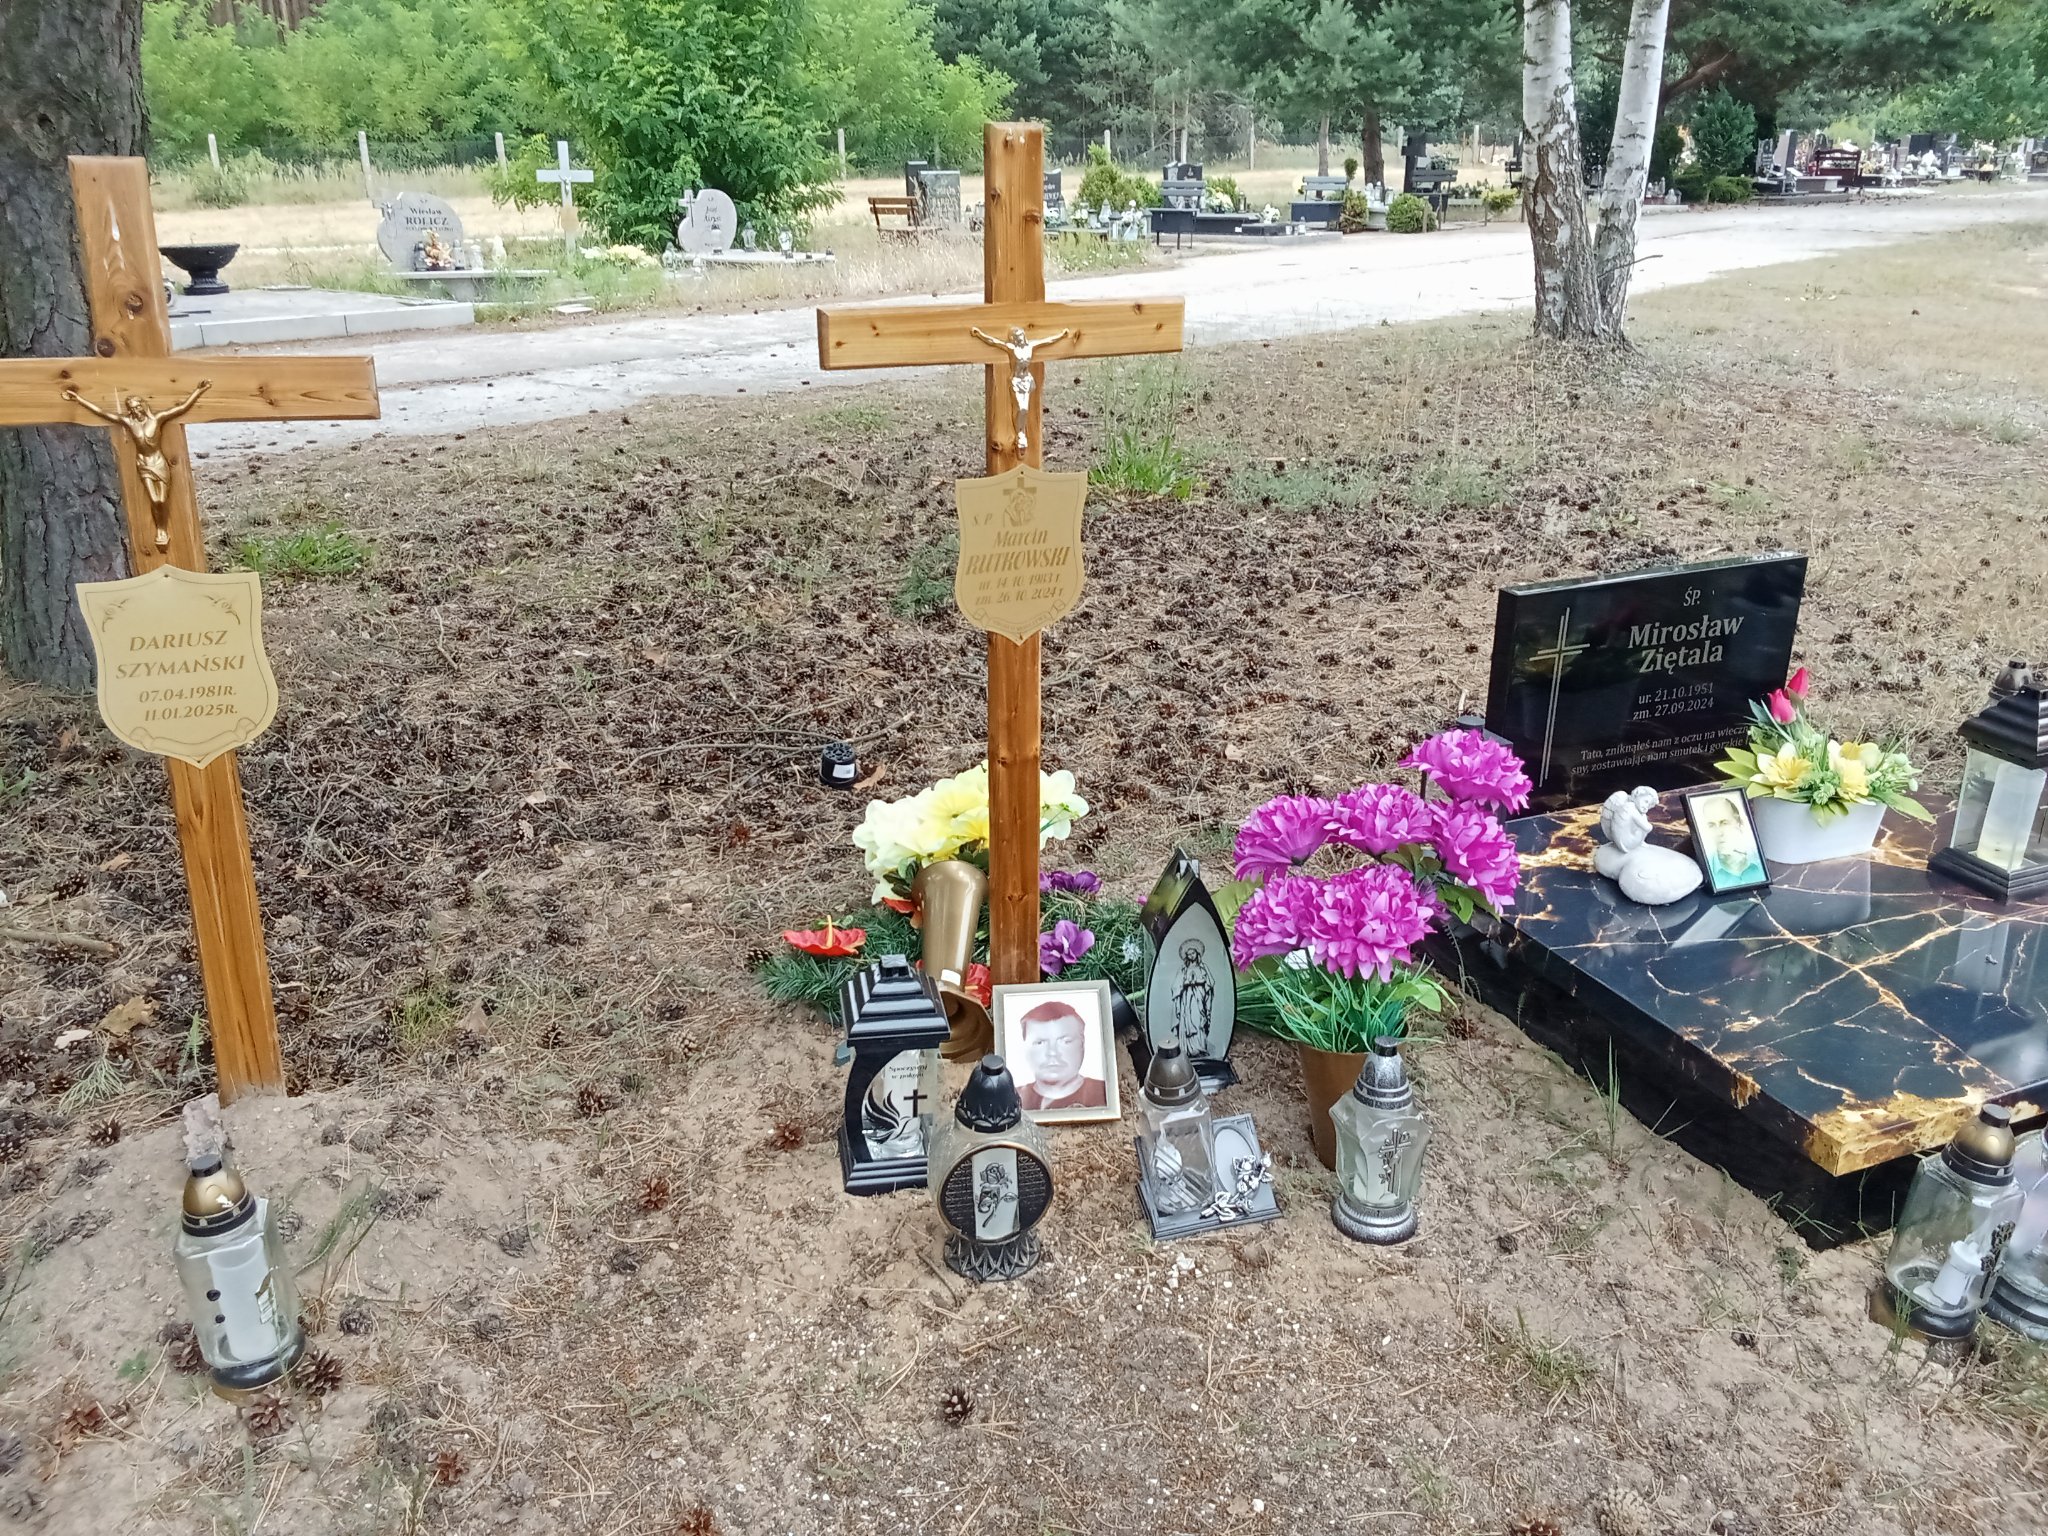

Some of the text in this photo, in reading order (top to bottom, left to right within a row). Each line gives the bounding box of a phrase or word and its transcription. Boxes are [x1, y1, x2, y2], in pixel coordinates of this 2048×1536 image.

[994, 528, 1048, 548] Marcin
[966, 546, 1070, 575] RUTKOWSKI
[129, 630, 228, 652] DARIUSZ
[1628, 614, 1744, 648] Mirosław
[116, 654, 245, 680] SZYMAŃSKI
[1638, 640, 1724, 675] Ziętala
[1638, 682, 1714, 705] ur. 21.10.1951
[1632, 697, 1714, 721] zm. 27.09.2024
[1580, 750, 1603, 760] Tato,
[1652, 738, 1672, 748] nam
[1674, 736, 1680, 744] z
[1681, 733, 1702, 744] oczu
[1704, 731, 1716, 740] na
[1646, 751, 1668, 762] nam
[1670, 742, 1703, 758] smutek
[1709, 737, 1744, 753] gorzkie
